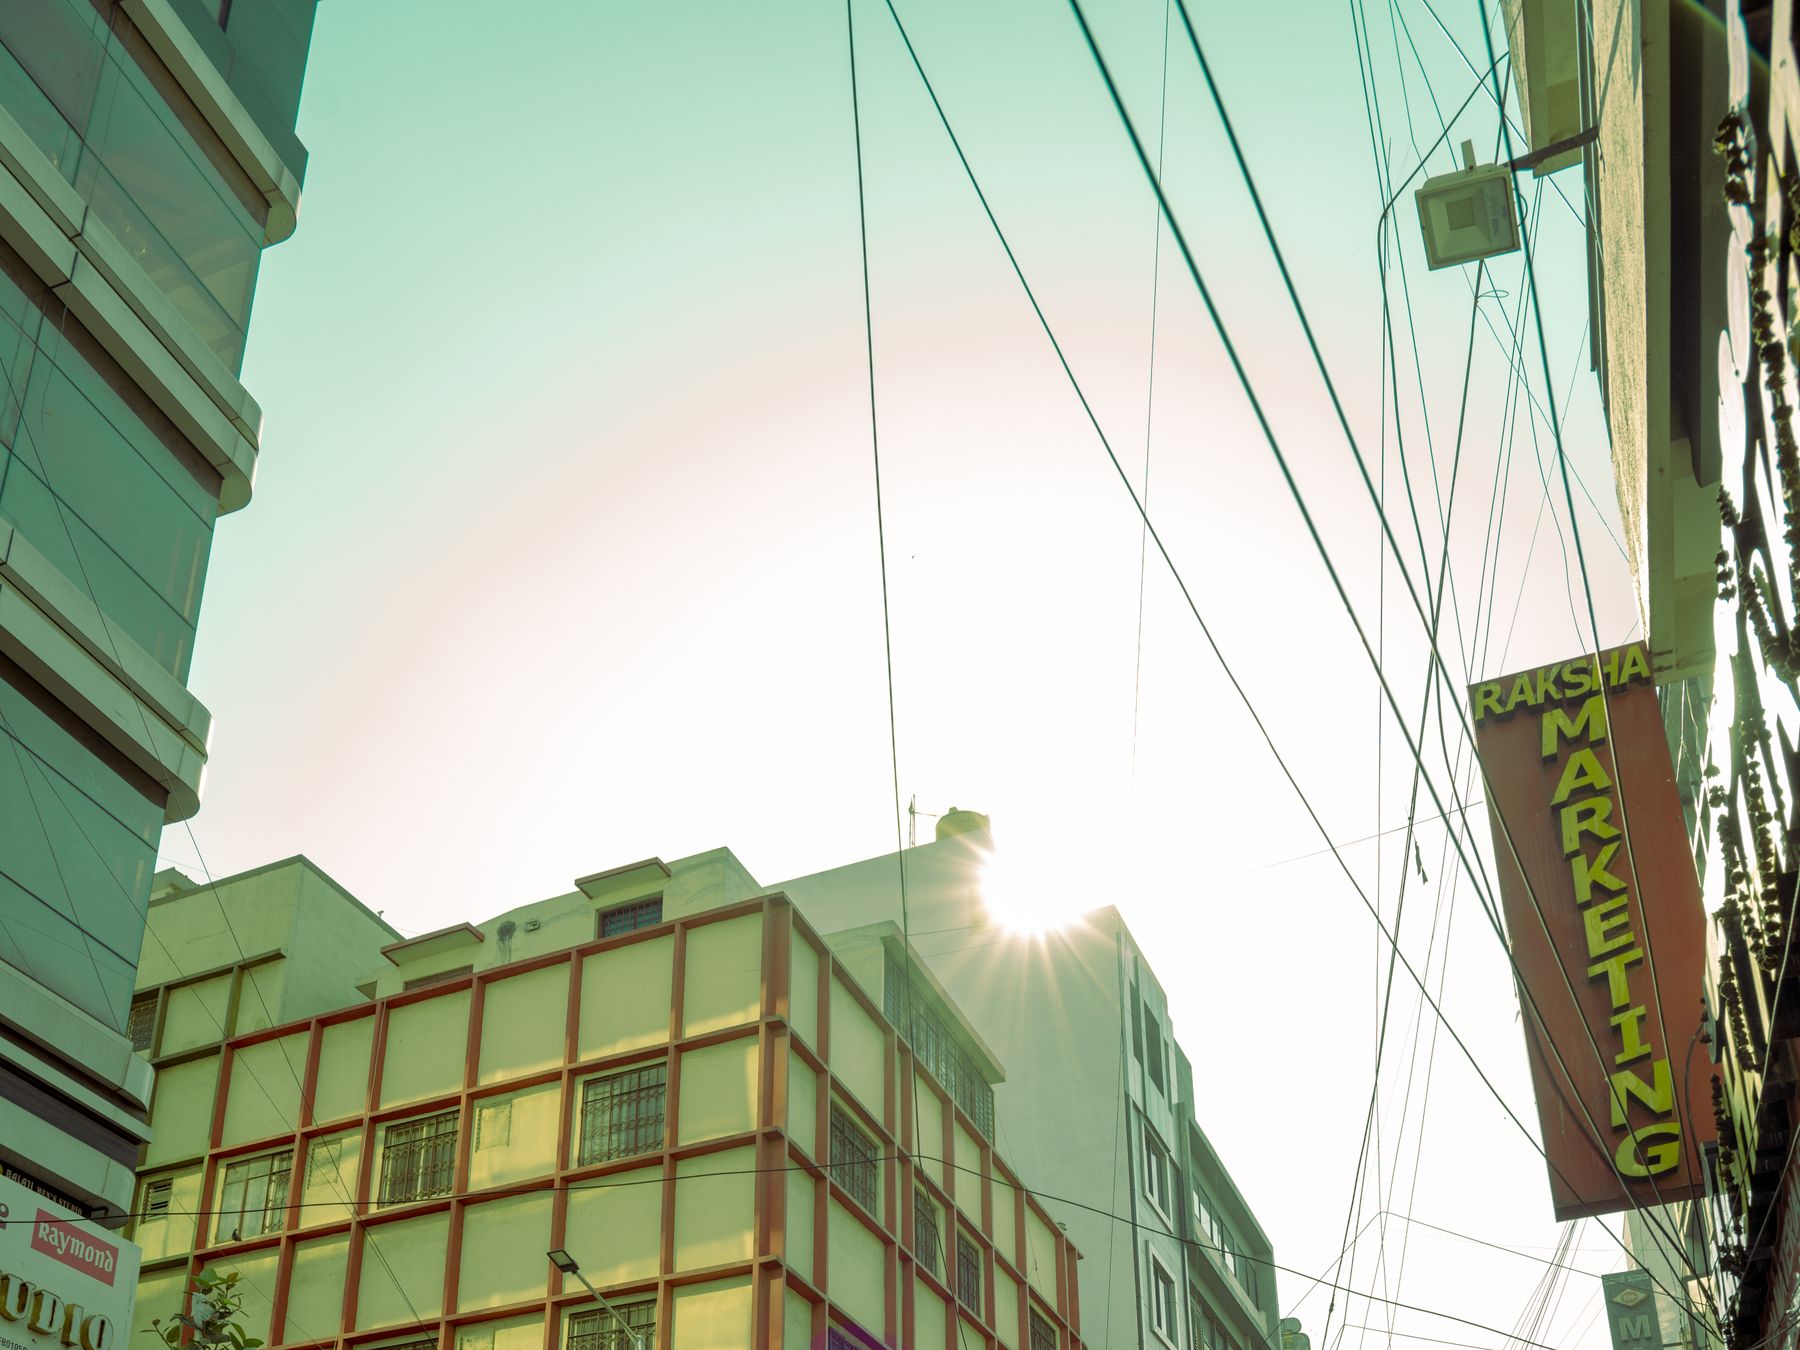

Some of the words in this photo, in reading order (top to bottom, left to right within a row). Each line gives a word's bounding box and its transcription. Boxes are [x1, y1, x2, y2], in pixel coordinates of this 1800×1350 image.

[1474, 642, 1653, 727] RAKSHA
[1540, 692, 1684, 1181] MARKETING
[59, 1197, 83, 1216] STUDIO
[38, 1221, 114, 1273] Raymond
